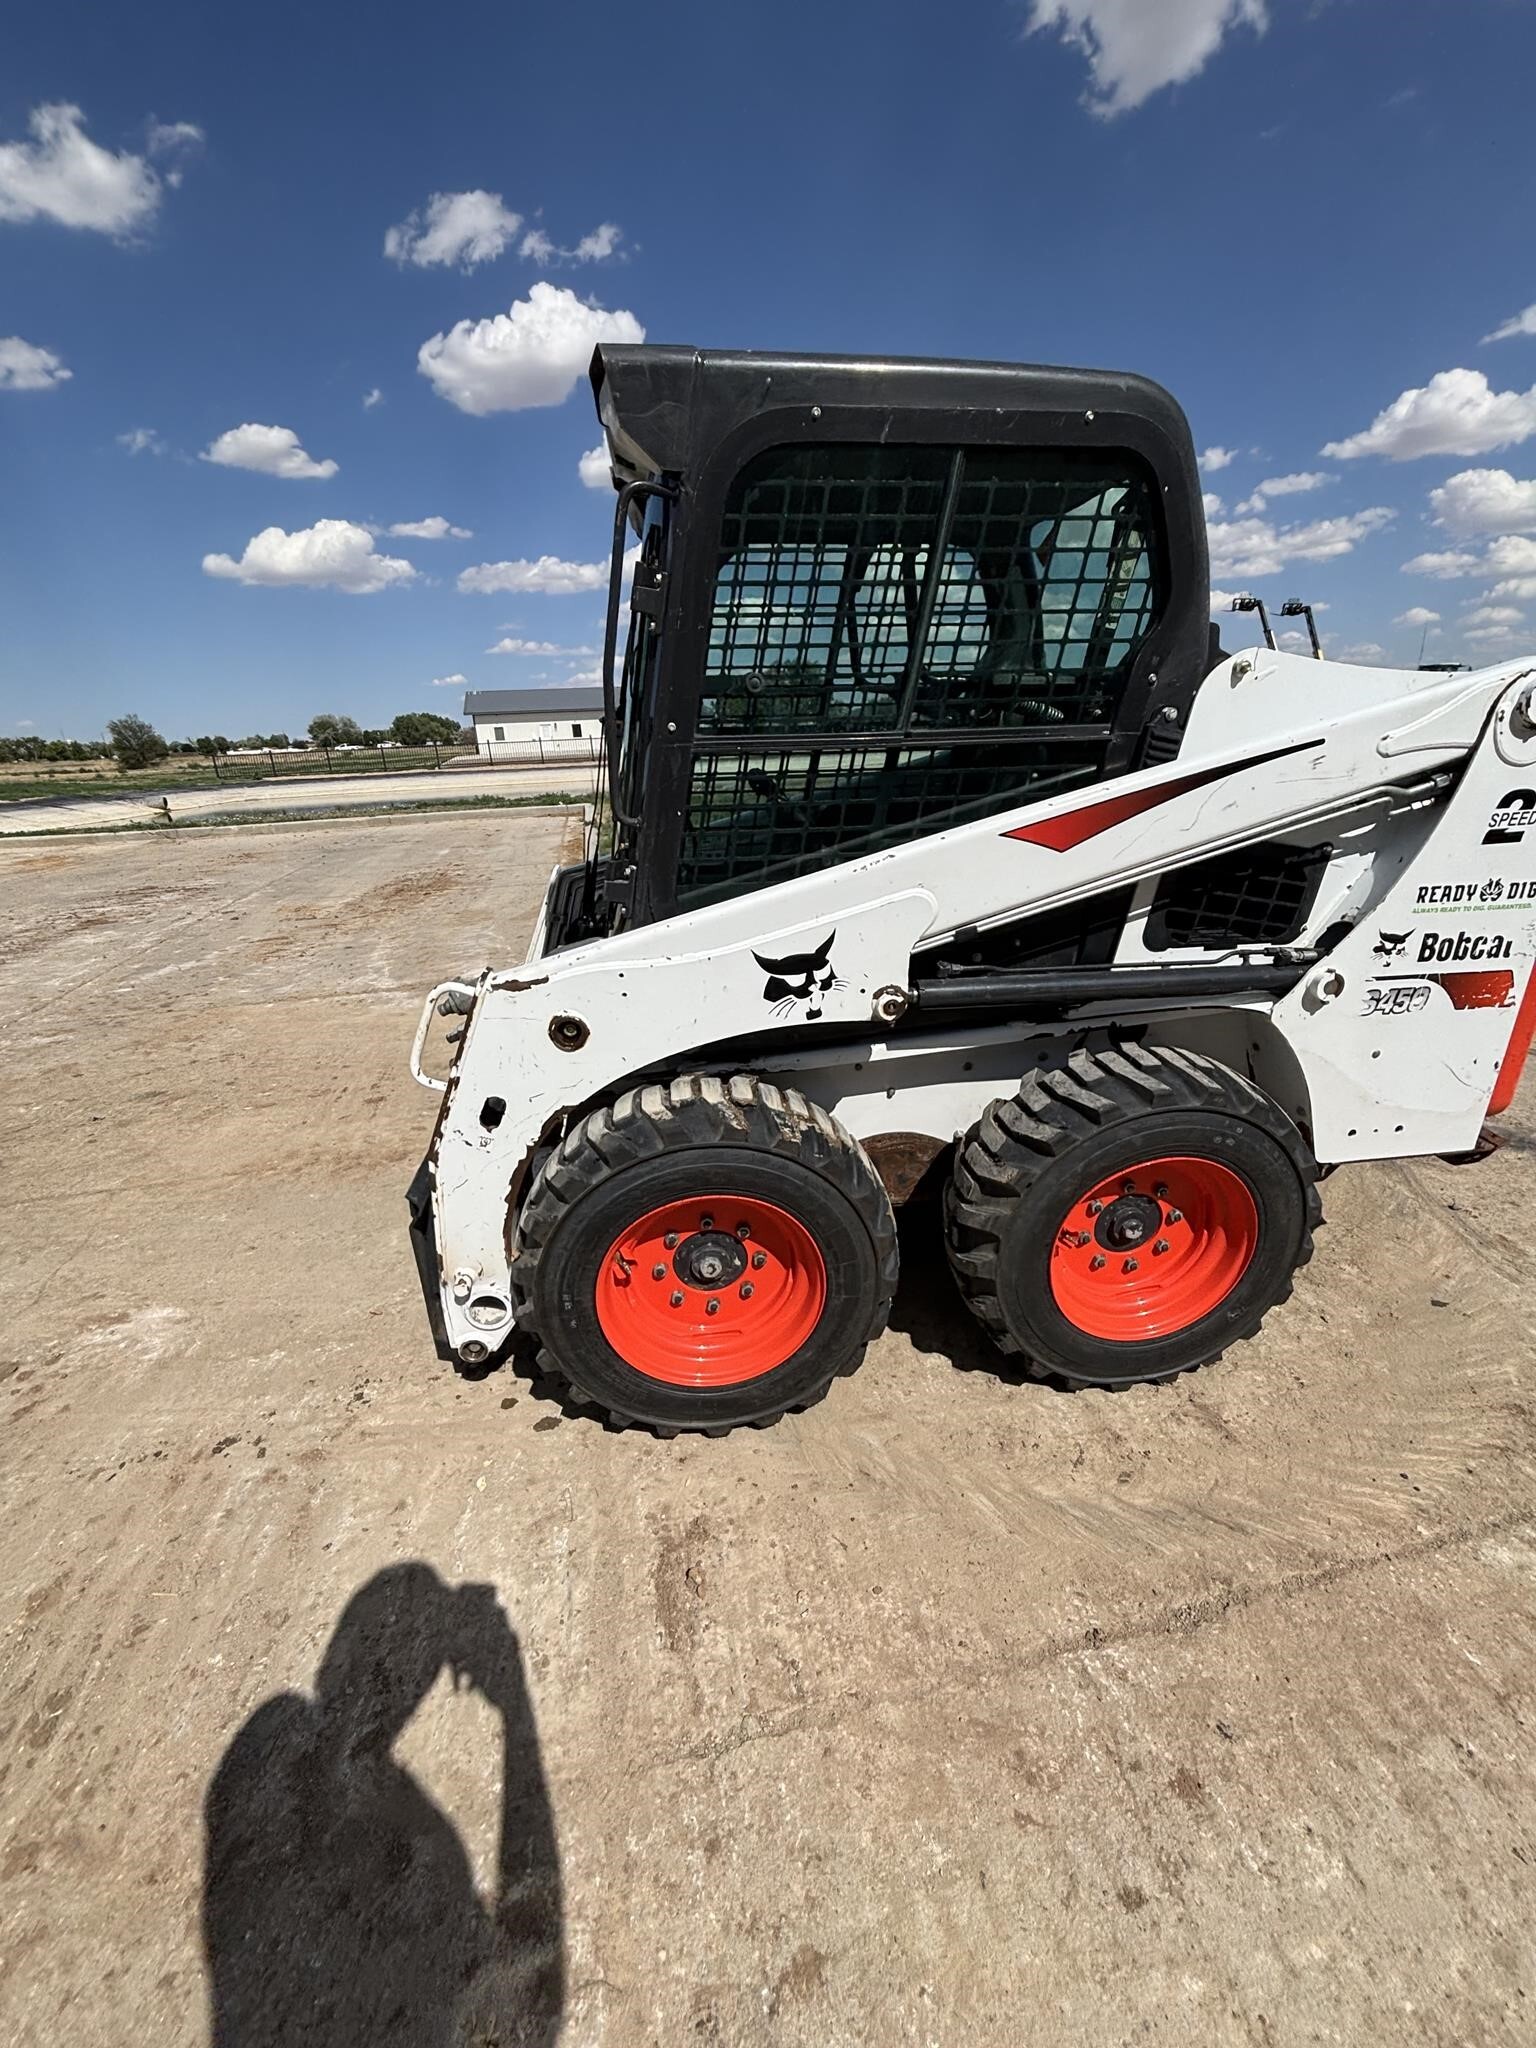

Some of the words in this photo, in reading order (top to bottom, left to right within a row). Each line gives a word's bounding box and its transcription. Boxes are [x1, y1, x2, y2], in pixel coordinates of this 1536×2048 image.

[1481, 788, 1536, 845] 2
[1488, 811, 1536, 828] SPEED
[1416, 884, 1478, 903] READY
[1507, 881, 1536, 899] DIG
